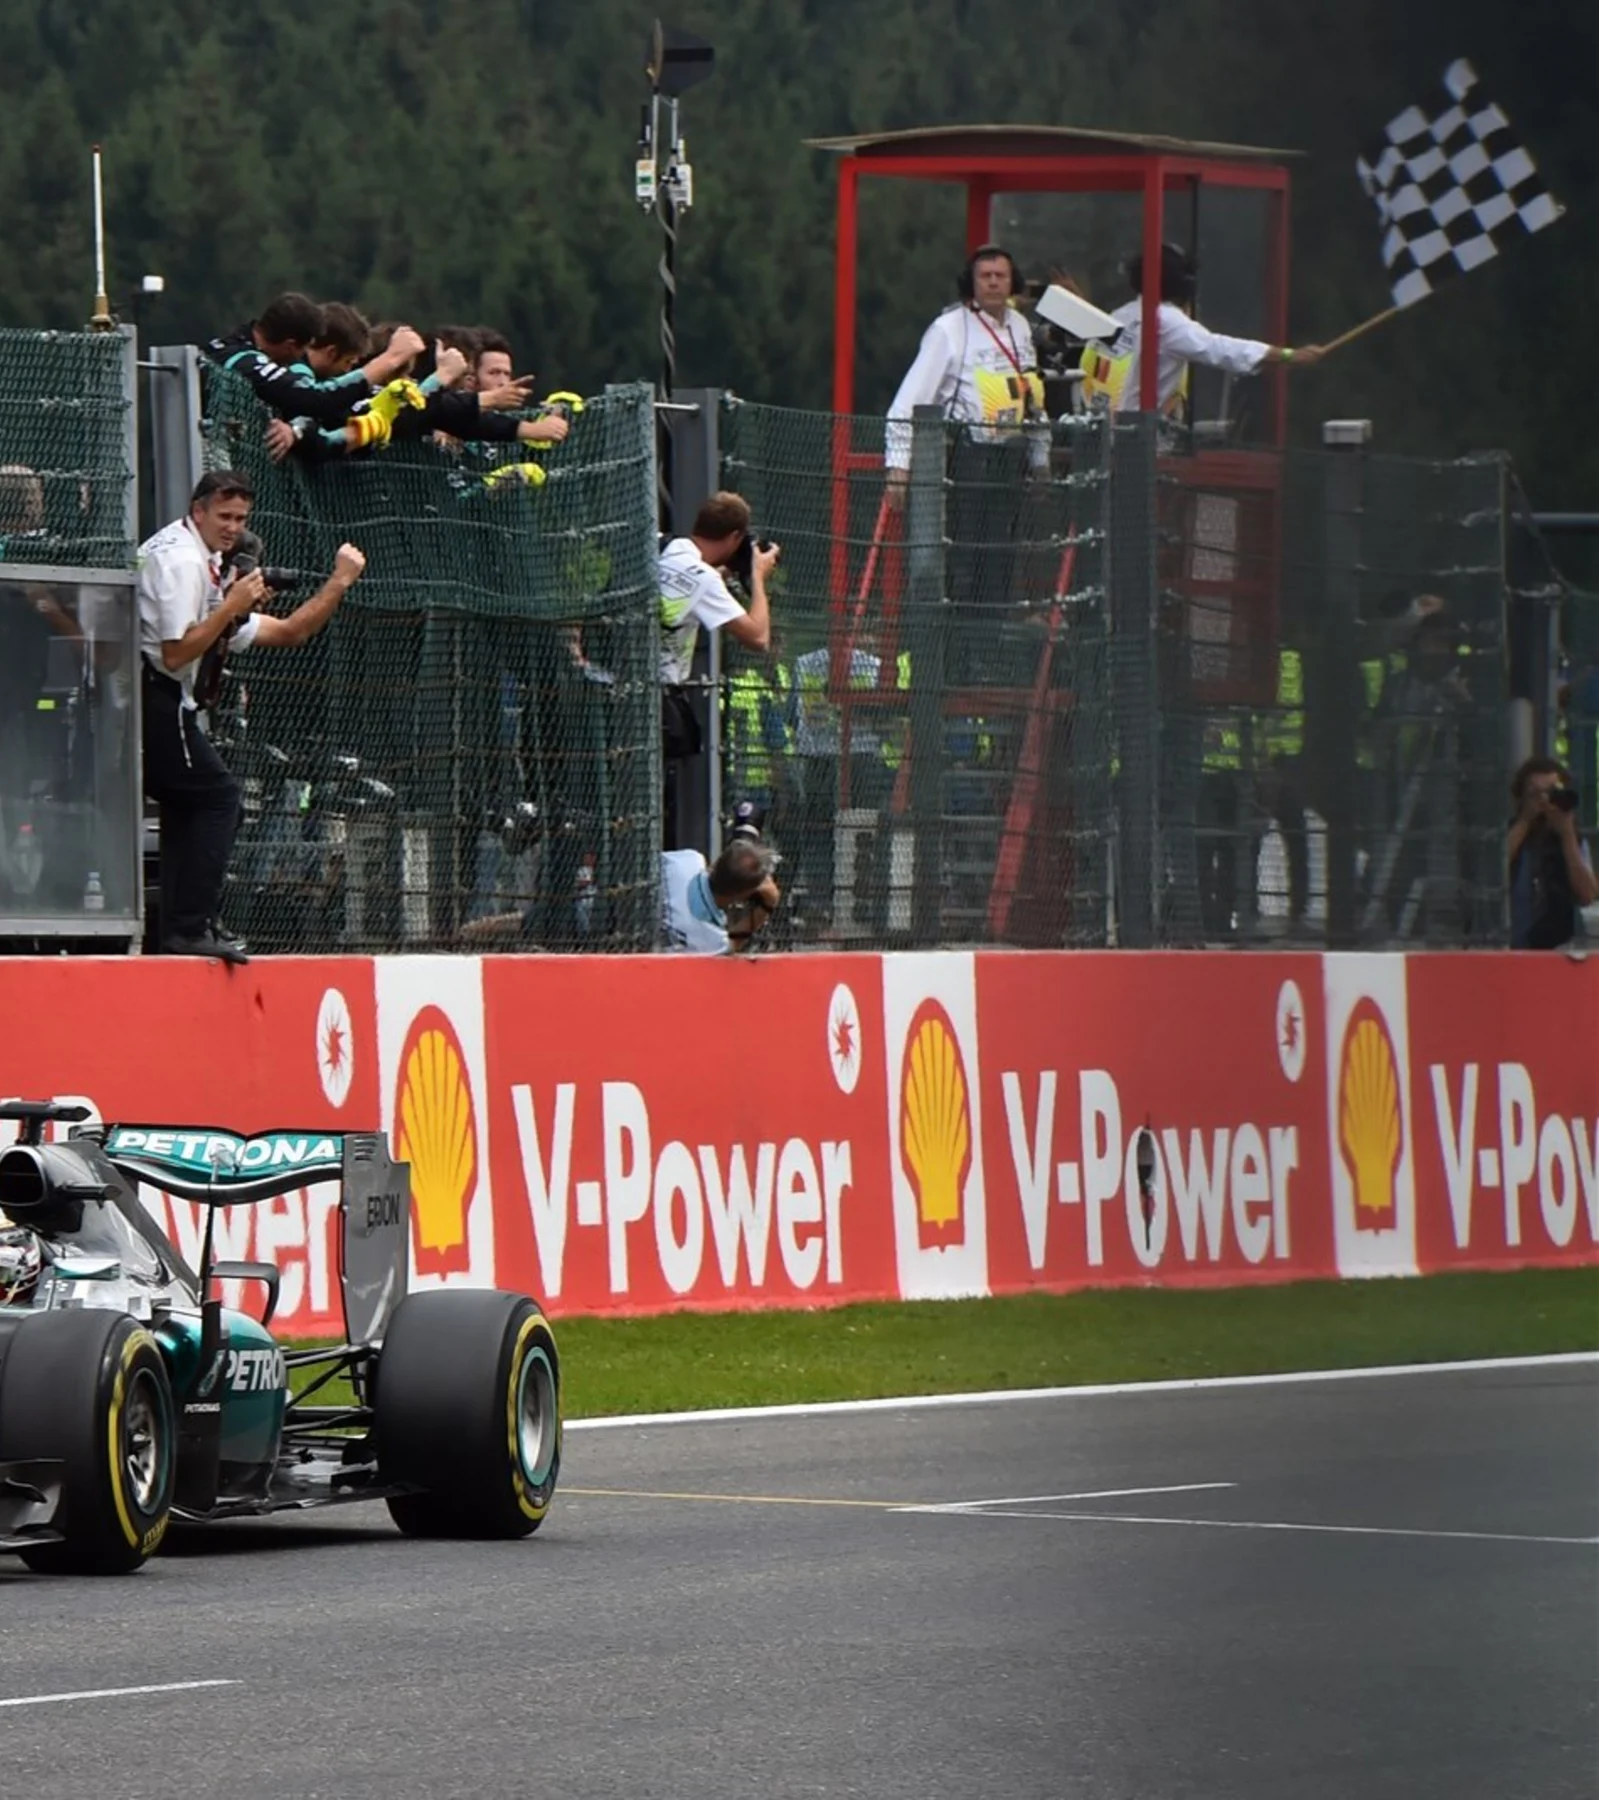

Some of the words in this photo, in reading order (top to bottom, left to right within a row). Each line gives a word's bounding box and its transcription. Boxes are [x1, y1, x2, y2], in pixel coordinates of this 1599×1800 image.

[114, 1131, 342, 1167] PETRONA
[511, 1080, 853, 1299] V-Power
[1001, 1069, 1298, 1270] V-Power
[225, 1348, 286, 1391] PETRO
